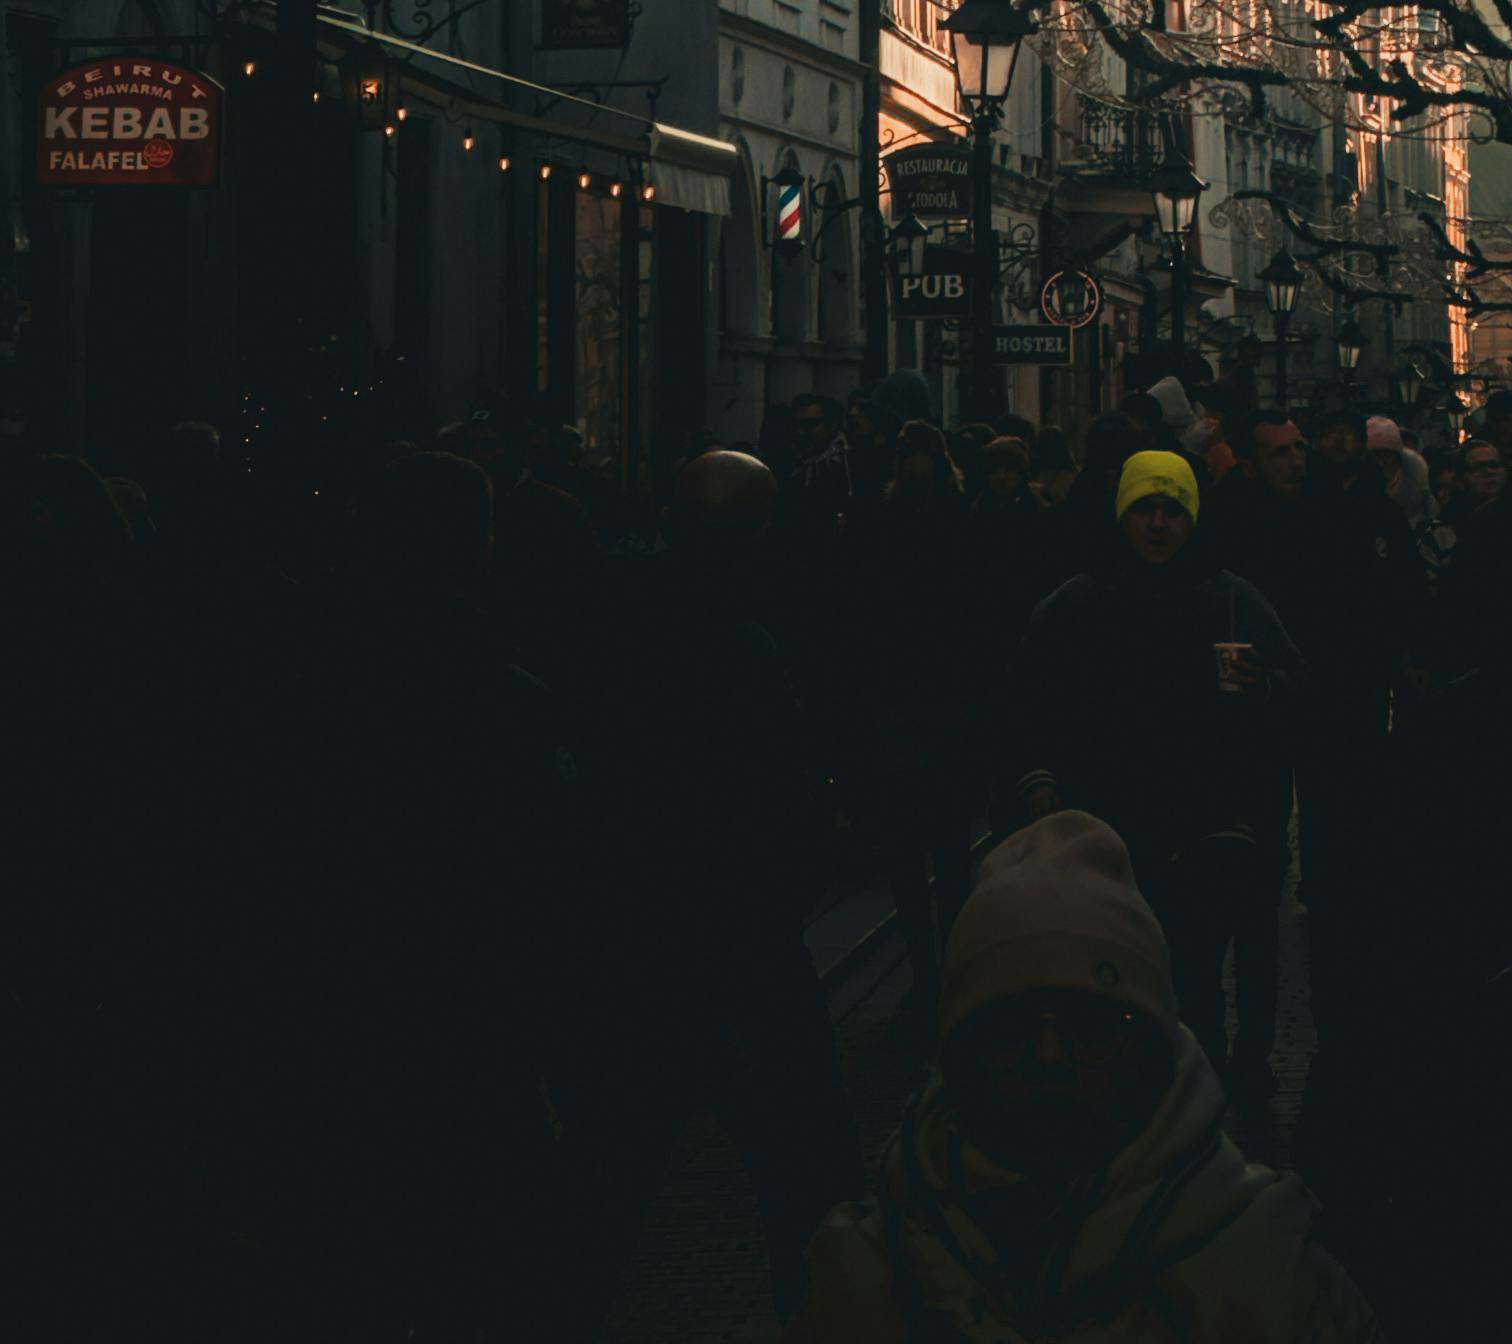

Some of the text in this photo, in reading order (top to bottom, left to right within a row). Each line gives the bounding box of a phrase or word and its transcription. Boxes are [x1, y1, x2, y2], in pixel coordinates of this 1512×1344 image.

[56, 64, 208, 99] BEIRUT
[83, 82, 173, 102] SHAWARMA
[45, 106, 209, 140] KEBAB
[50, 151, 149, 171] FALAFEL
[896, 158, 968, 176] RESTAURACJA
[902, 274, 965, 299] PUB
[995, 336, 1067, 353] HOSTEL
